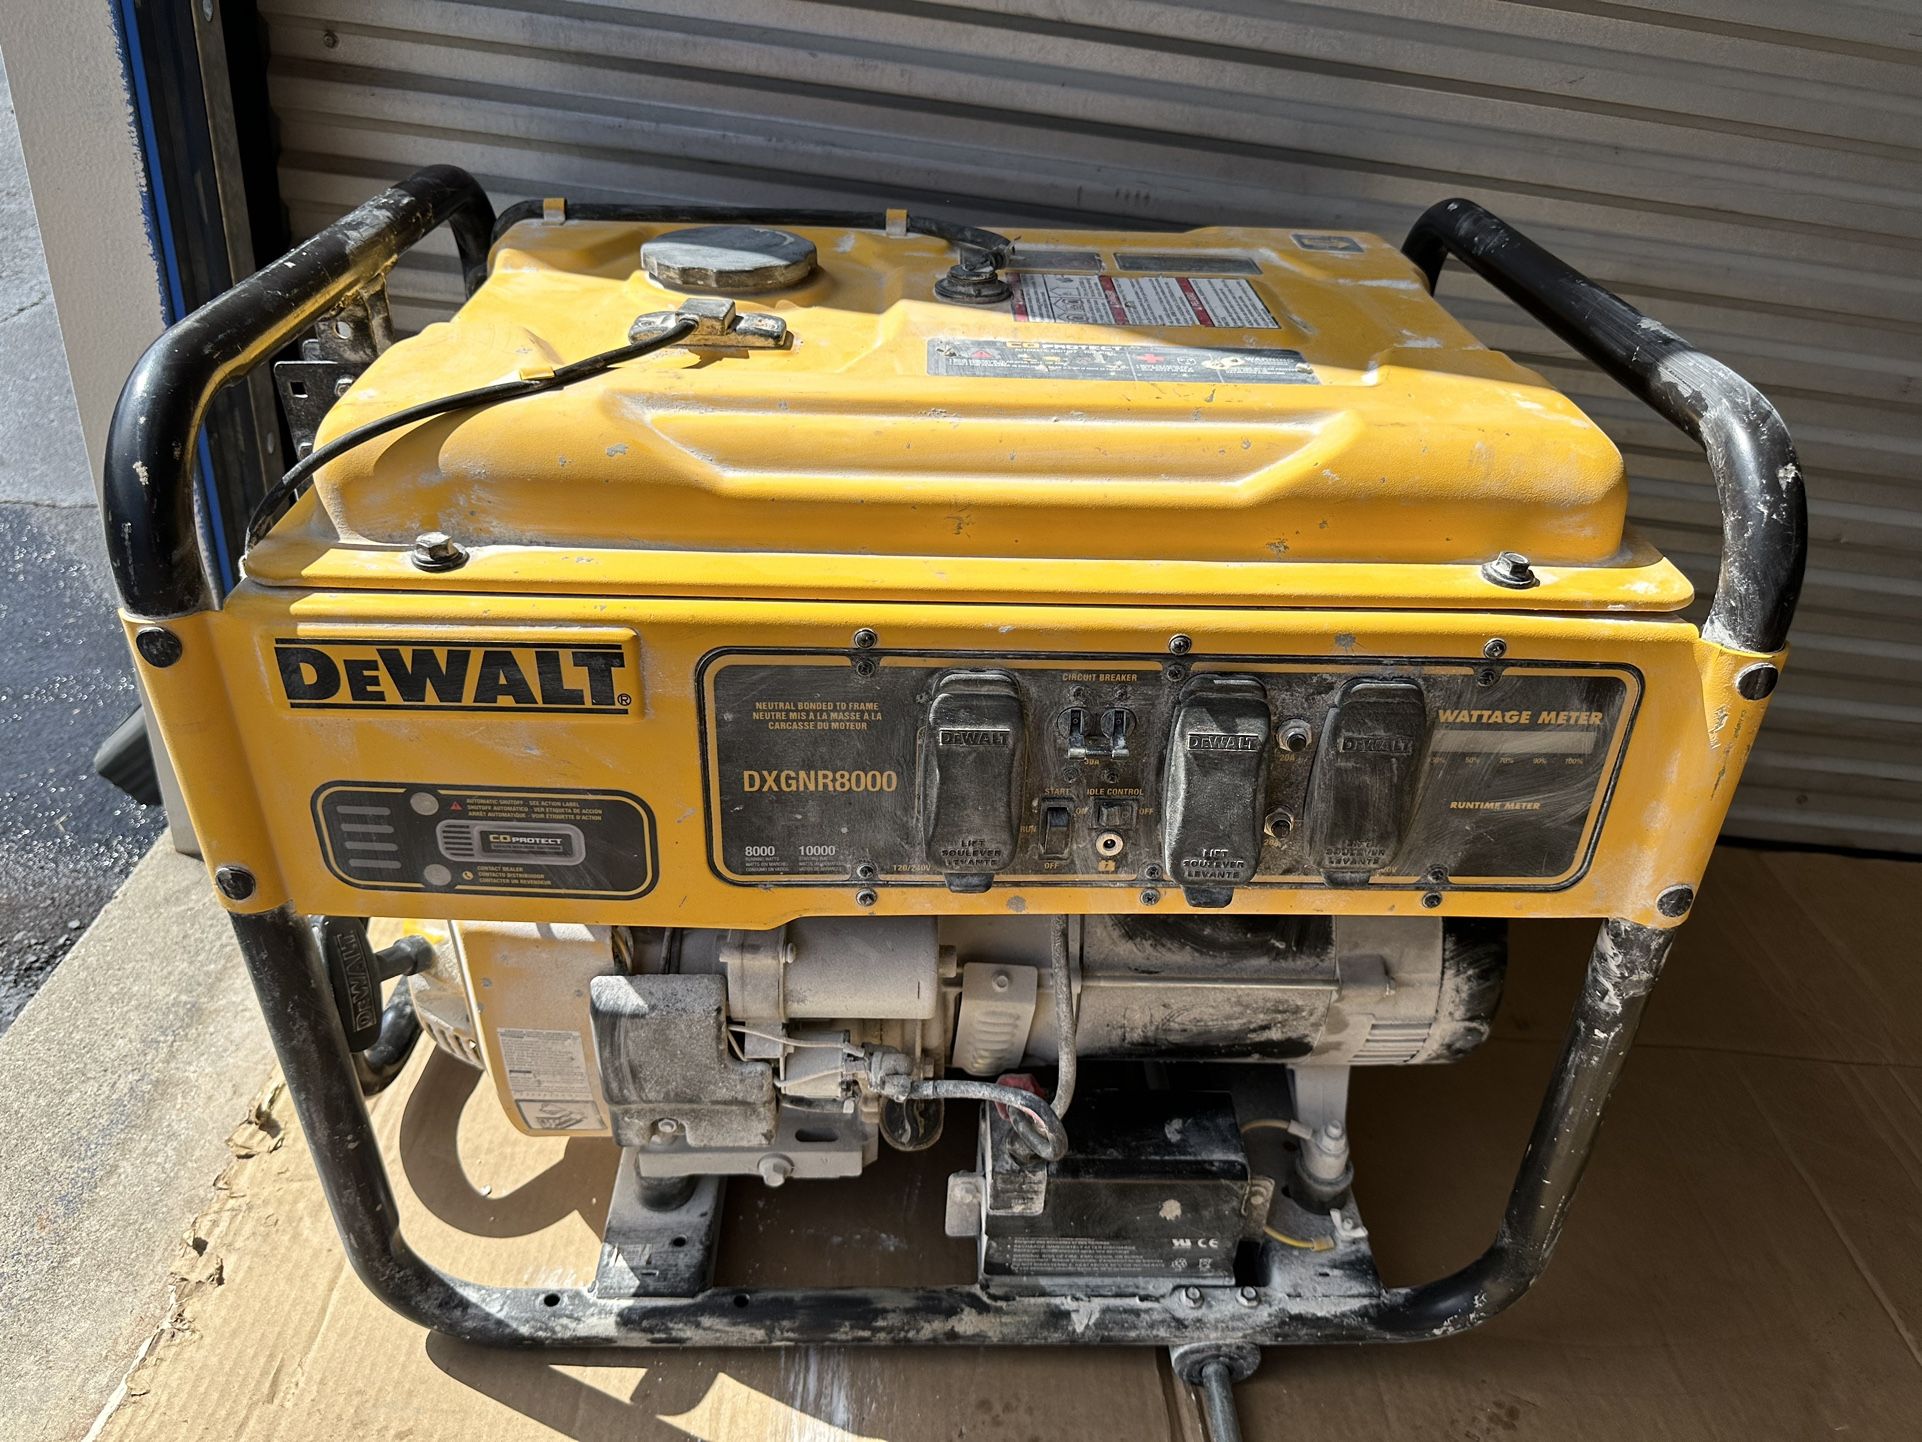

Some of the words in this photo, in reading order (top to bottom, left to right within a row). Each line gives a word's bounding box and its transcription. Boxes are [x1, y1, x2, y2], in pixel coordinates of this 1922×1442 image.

[1062, 673, 1097, 681] CIRCUIT
[1099, 673, 1138, 681] BREAKER
[755, 701, 796, 710] NEUTRAL
[798, 702, 834, 710] BONDED
[836, 702, 847, 710] TO
[849, 702, 879, 711] FRAME
[752, 711, 786, 720] NEUTRE
[789, 711, 807, 720] MIS
[817, 711, 828, 720] LA
[830, 711, 861, 720] MASSE
[871, 712, 882, 720] LA
[1438, 709, 1532, 724] WATTAGE
[1537, 711, 1603, 725] METER
[768, 721, 815, 730] CARCASSE
[817, 722, 829, 730] DU
[831, 722, 868, 731] MOTEUR
[743, 770, 898, 792] DXGNR8000
[1044, 788, 1070, 796] START
[1087, 788, 1104, 796] IDLE
[1106, 788, 1144, 796] CONTROL
[1450, 801, 1501, 810] RUNTIME
[1504, 802, 1541, 810] METER
[1020, 825, 1037, 833] RUN
[745, 846, 776, 857] 8000
[799, 845, 836, 856] 10000
[1044, 862, 1059, 870] OFF
